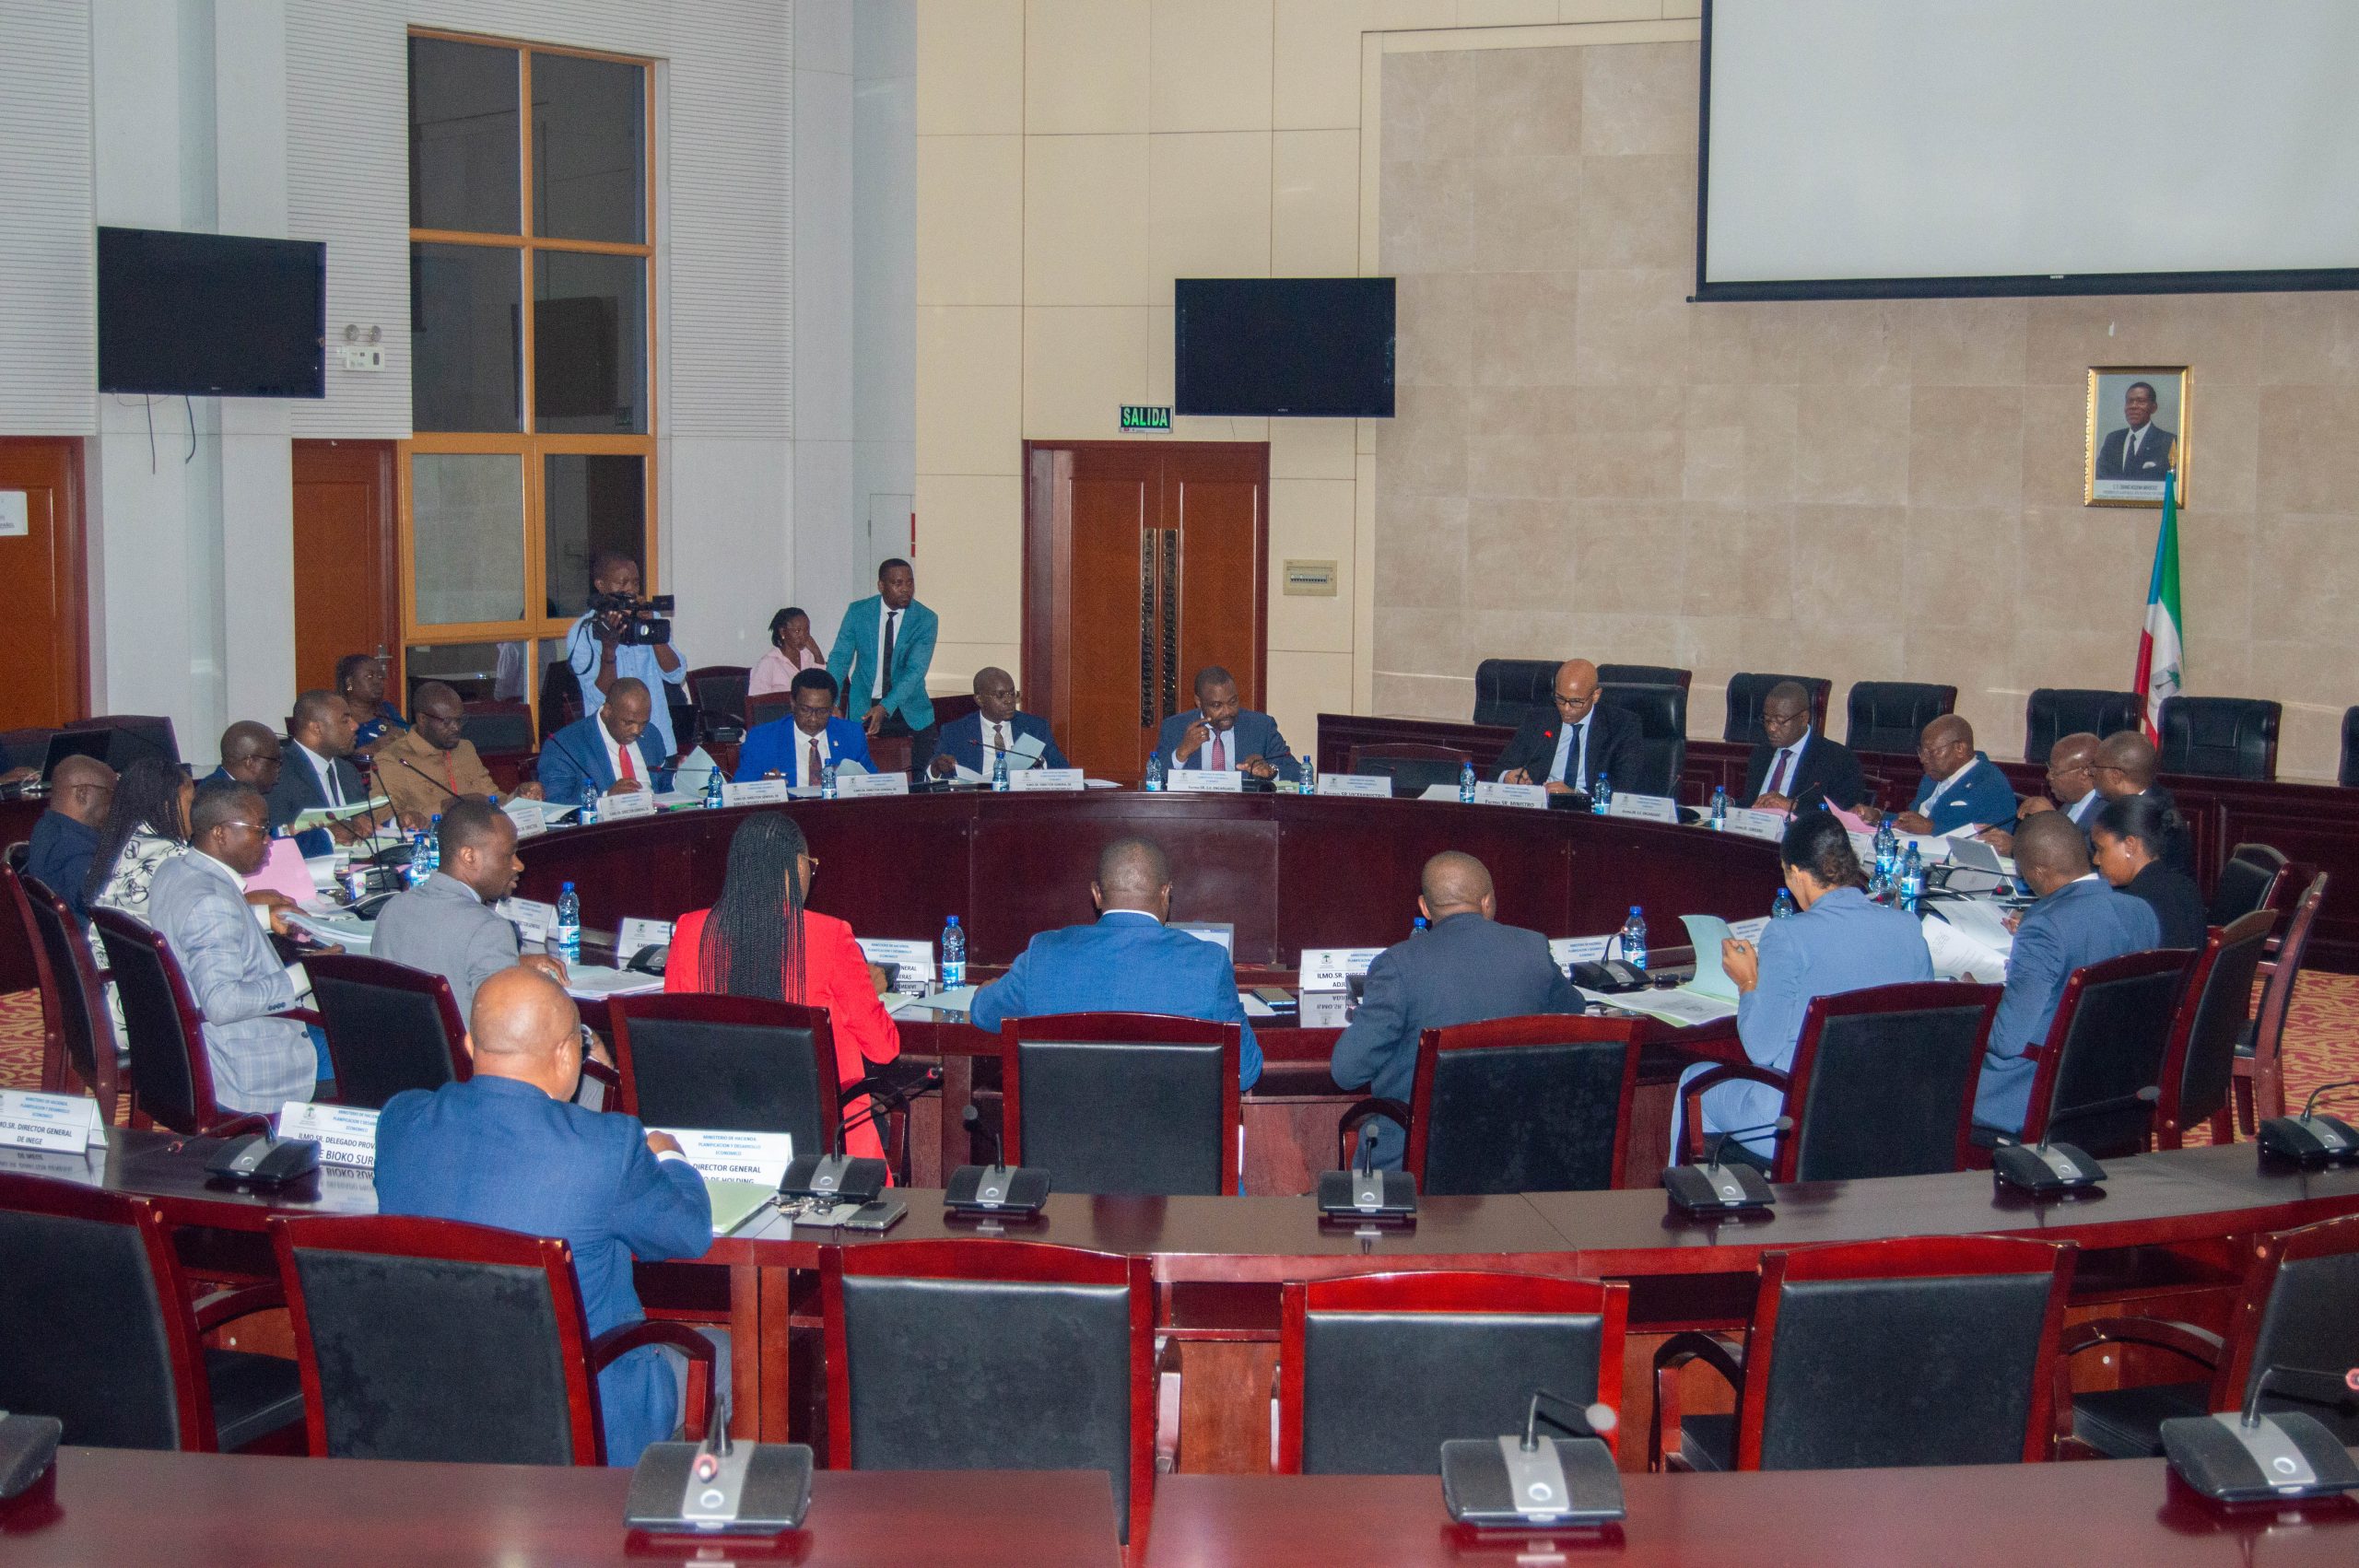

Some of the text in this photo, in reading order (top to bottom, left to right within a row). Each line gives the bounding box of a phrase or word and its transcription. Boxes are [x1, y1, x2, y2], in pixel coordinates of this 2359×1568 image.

[1123, 407, 1168, 427] SALIDA
[18, 1123, 45, 1133] DIRECTOR
[46, 1127, 73, 1137] GENERAL
[25, 1137, 43, 1145] INEGE
[325, 1136, 358, 1147] DELEGADO
[326, 1150, 354, 1163] BIOKO
[356, 1154, 374, 1165] SUR
[693, 1164, 761, 1174] DIRECTOR GENERAL
